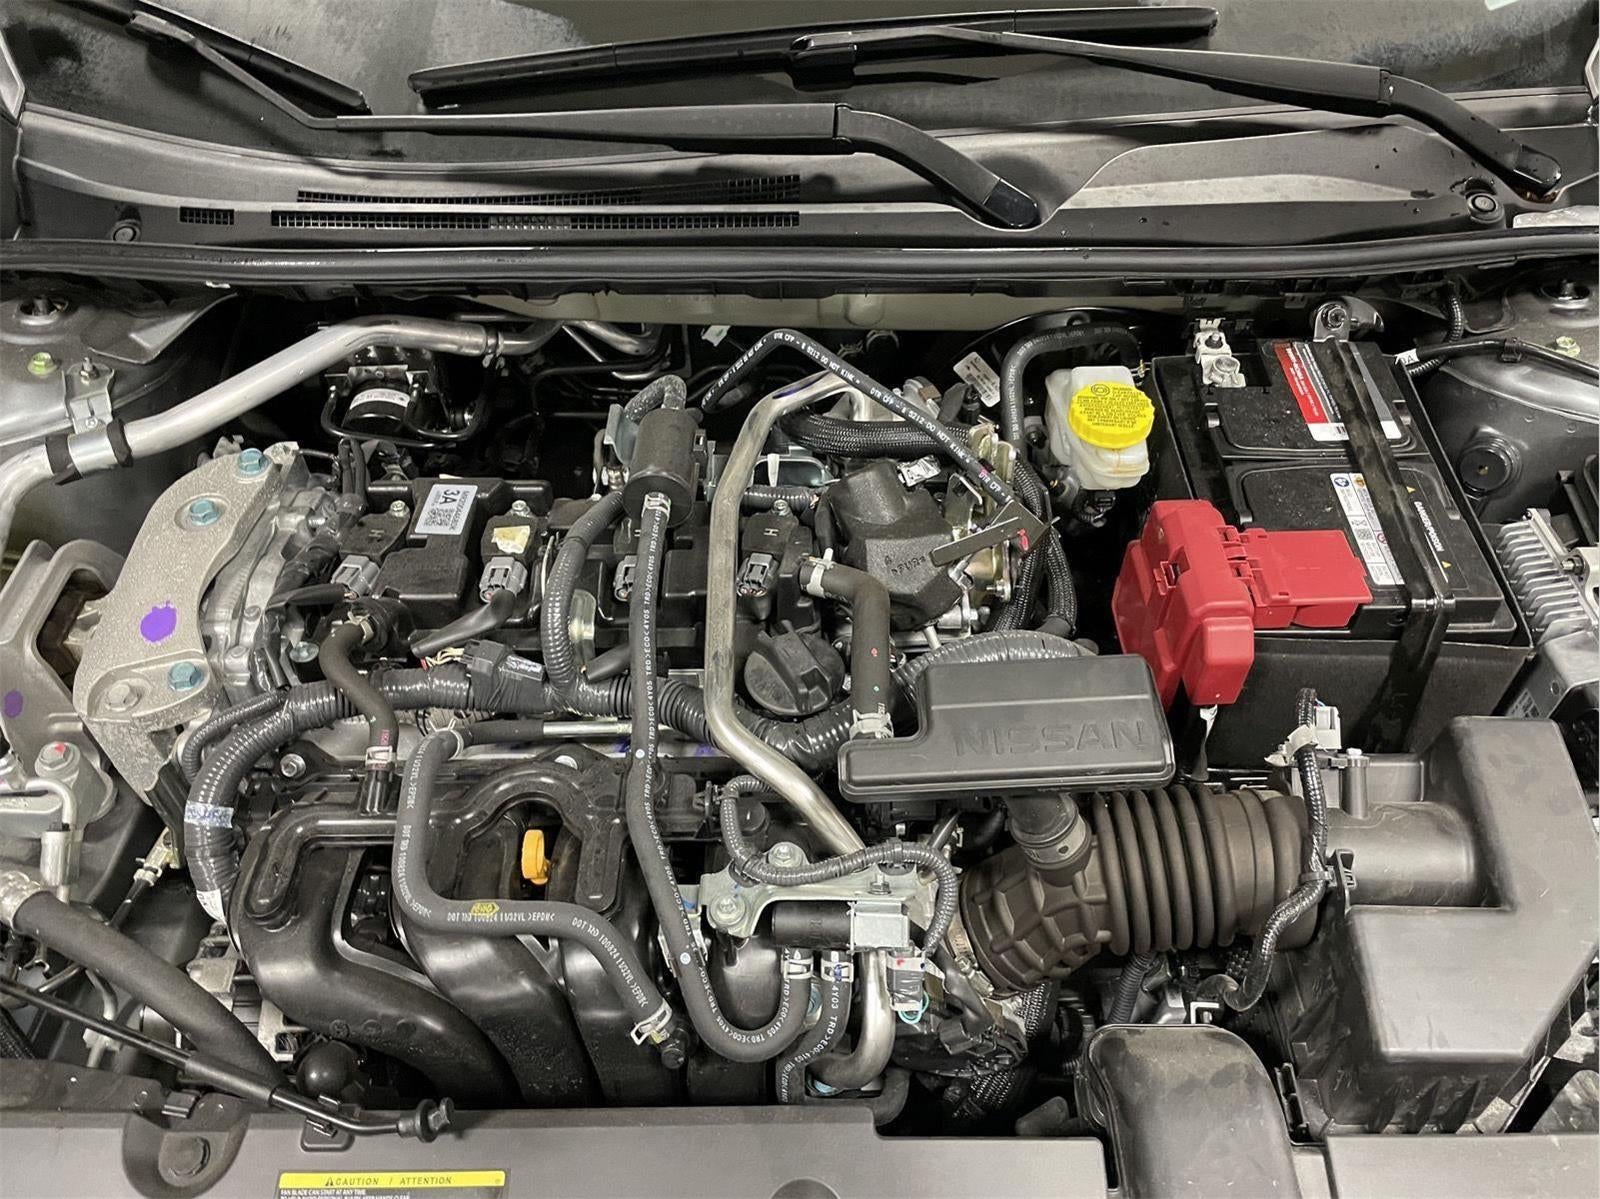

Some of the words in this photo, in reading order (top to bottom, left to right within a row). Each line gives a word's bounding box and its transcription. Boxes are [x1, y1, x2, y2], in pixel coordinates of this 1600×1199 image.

[840, 368, 856, 384] KINK
[936, 431, 950, 444] NOT
[440, 489, 460, 505] 3A
[648, 680, 656, 744] TRD>ECO<4Y05
[955, 719, 1145, 757] NISSAN
[447, 912, 460, 922] DOT
[572, 916, 587, 931] DOT
[598, 934, 620, 960] 100824
[336, 1178, 379, 1186] CAUTION
[400, 1176, 452, 1185] ATTENTION
